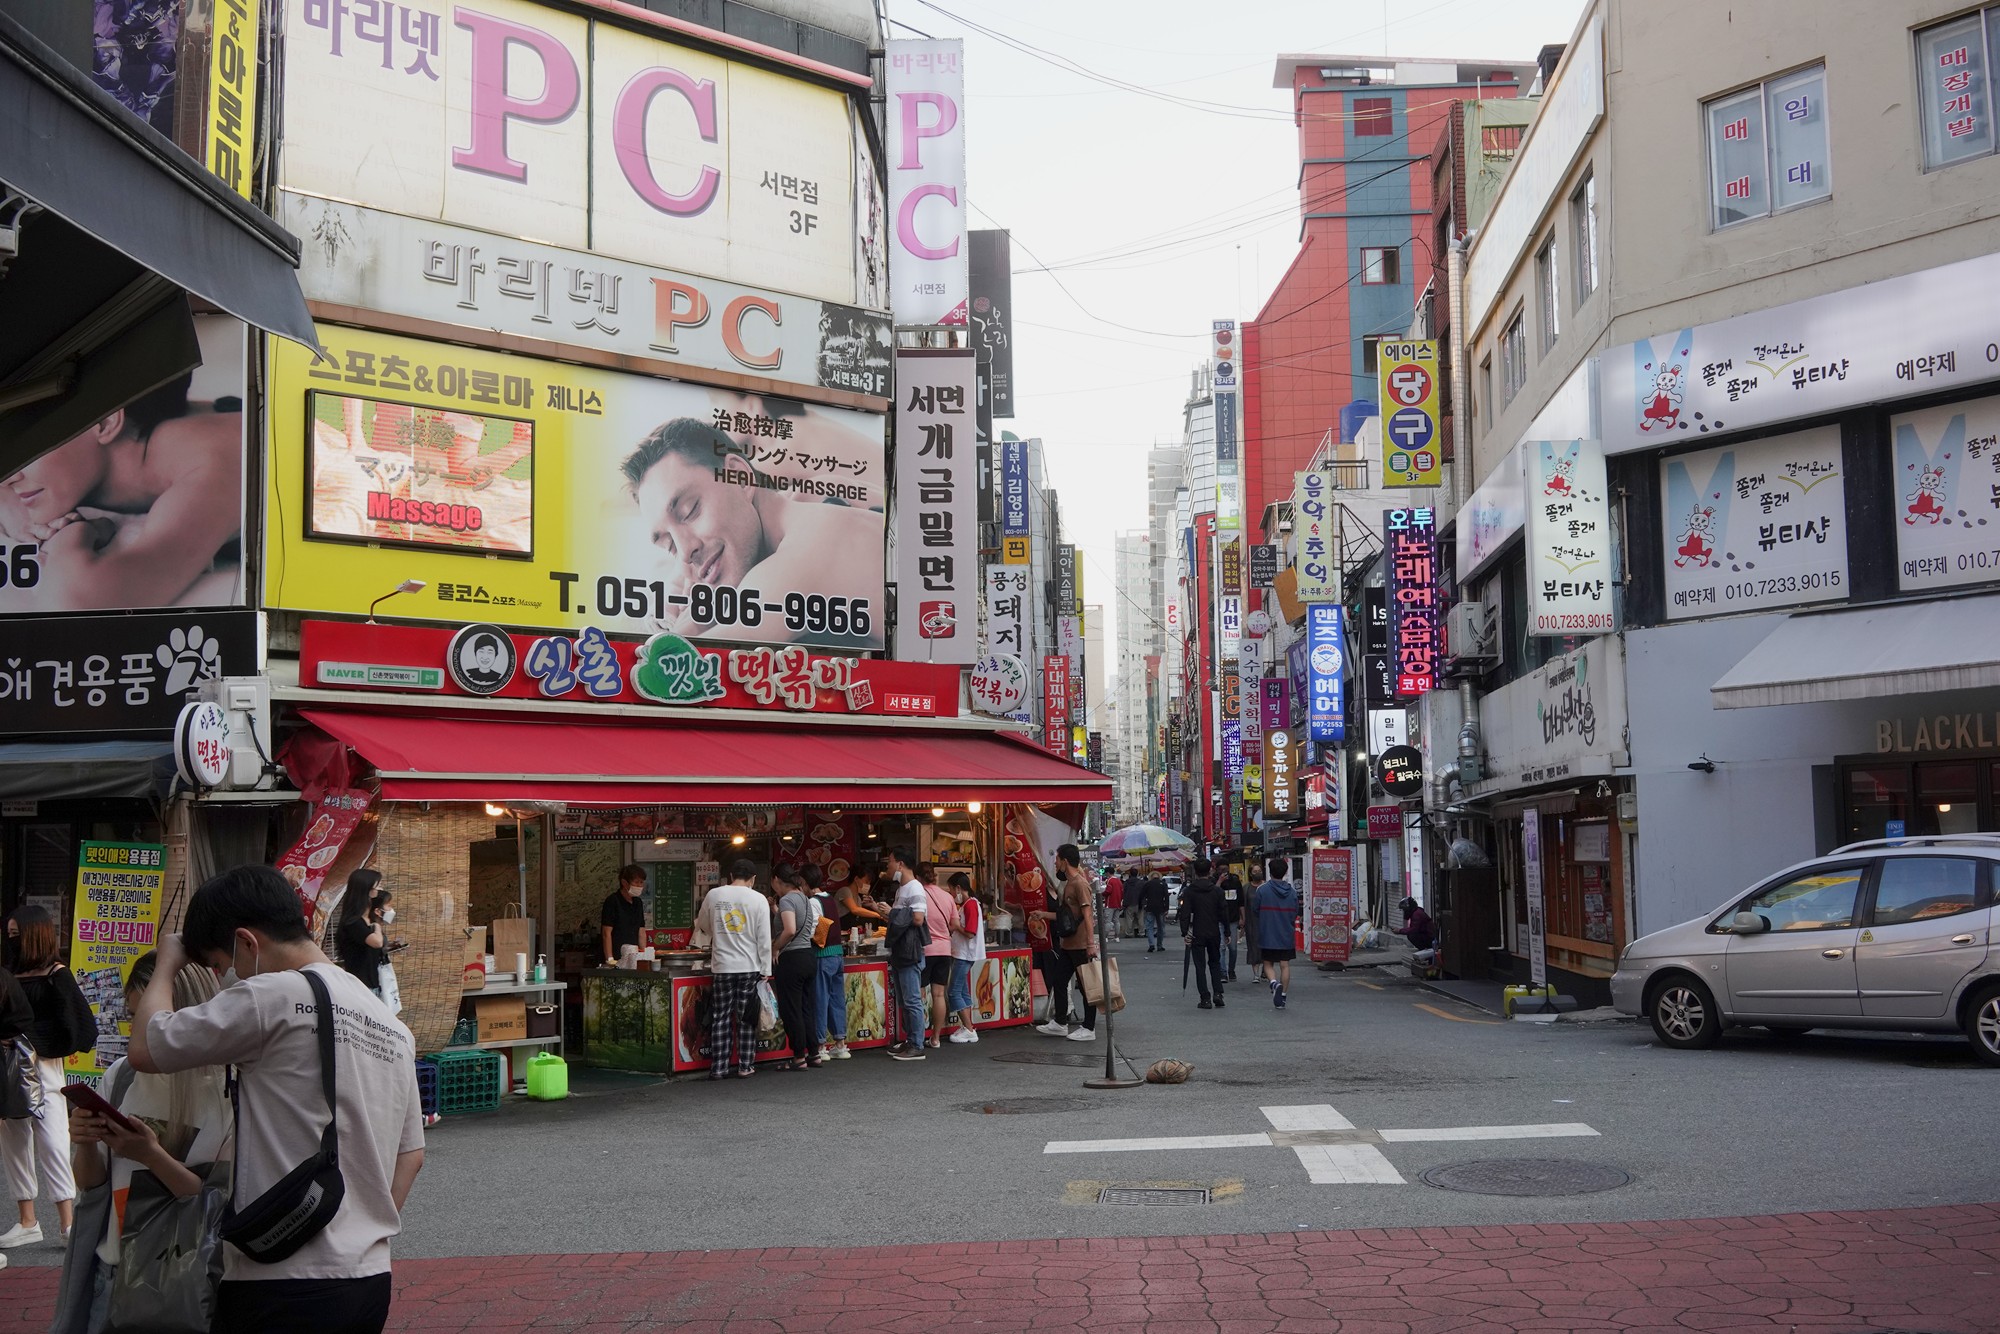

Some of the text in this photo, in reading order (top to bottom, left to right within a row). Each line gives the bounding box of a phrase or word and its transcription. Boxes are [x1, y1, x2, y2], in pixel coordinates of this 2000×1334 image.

[303, 0, 441, 82] 바리넷
[892, 53, 957, 74] 바리넷
[1939, 46, 1976, 139] 매장개발
[452, 5, 721, 218] PC
[1784, 95, 1812, 185] 임대
[1723, 117, 1750, 199] 매매
[760, 171, 819, 206] 서면점
[895, 90, 960, 260] PC
[789, 209, 819, 236] 3F
[418, 238, 783, 371] 바리넷 PC
[912, 282, 947, 296] 서면점
[952, 308, 967, 321] 3F
[1384, 343, 1432, 361] 에이스
[1753, 341, 1806, 361] 걸어온나
[1896, 350, 1956, 382] 예약제
[308, 346, 602, 416] 스포츠&아로마 제니스
[831, 370, 886, 394] 서면점 3F
[1791, 357, 1850, 391] 뷰티샵
[906, 384, 966, 416] 서면
[1391, 371, 1428, 445] 당구
[712, 407, 794, 441] 治愈按摩
[355, 454, 495, 493] マッサージ
[1008, 442, 1022, 476] 세무사
[1784, 460, 1834, 478] 걸어온나
[714, 467, 868, 502] HEALING MASSAGE
[1405, 471, 1420, 482] 3F
[366, 490, 483, 532] Massage
[916, 422, 955, 592] 개금밀면
[1388, 508, 1433, 531] 오투
[1004, 528, 1029, 536] 803-0111
[1758, 515, 1832, 553] 뷰티샵
[1304, 537, 1327, 584] 추억
[1551, 546, 1596, 561] 걸어온나
[1903, 556, 1948, 579] 예약제
[993, 570, 1028, 592] 풍성
[1060, 547, 1073, 600] 피아노소리
[1673, 569, 1841, 608] 예약제 010.7233.9015
[437, 582, 543, 610] 풀코스 스포츠 Massage
[1396, 534, 1435, 675] 노래연습장
[1542, 579, 1605, 602] 뷰티샵
[993, 596, 1023, 656] 돼지
[1168, 604, 1177, 624] PC
[1223, 598, 1238, 630] 서면
[1314, 608, 1339, 641] 맨즈
[1537, 613, 1613, 630] 010.7233.9015
[326, 668, 365, 679] NAVER
[526, 626, 622, 697] 신촌
[731, 647, 849, 708] 떡볶이
[1244, 641, 1261, 689] 이수영
[971, 674, 1020, 706] 떡볶이
[1315, 678, 1339, 712] 헤어
[1401, 676, 1431, 692] 코인
[888, 696, 932, 711] 서면본점
[1047, 656, 1067, 757] 부대찌개·부대구
[1244, 691, 1262, 738] 철학원
[1268, 700, 1282, 728] 핑크
[1321, 728, 1334, 736] 2F
[1876, 711, 2000, 754] BLACKL
[197, 739, 231, 775] 떡볶이
[1369, 814, 1400, 825] 화장품
[86, 847, 161, 866] 펫인애완용품점
[77, 918, 155, 945] 할인판매
[295, 1002, 319, 1014] Ros
